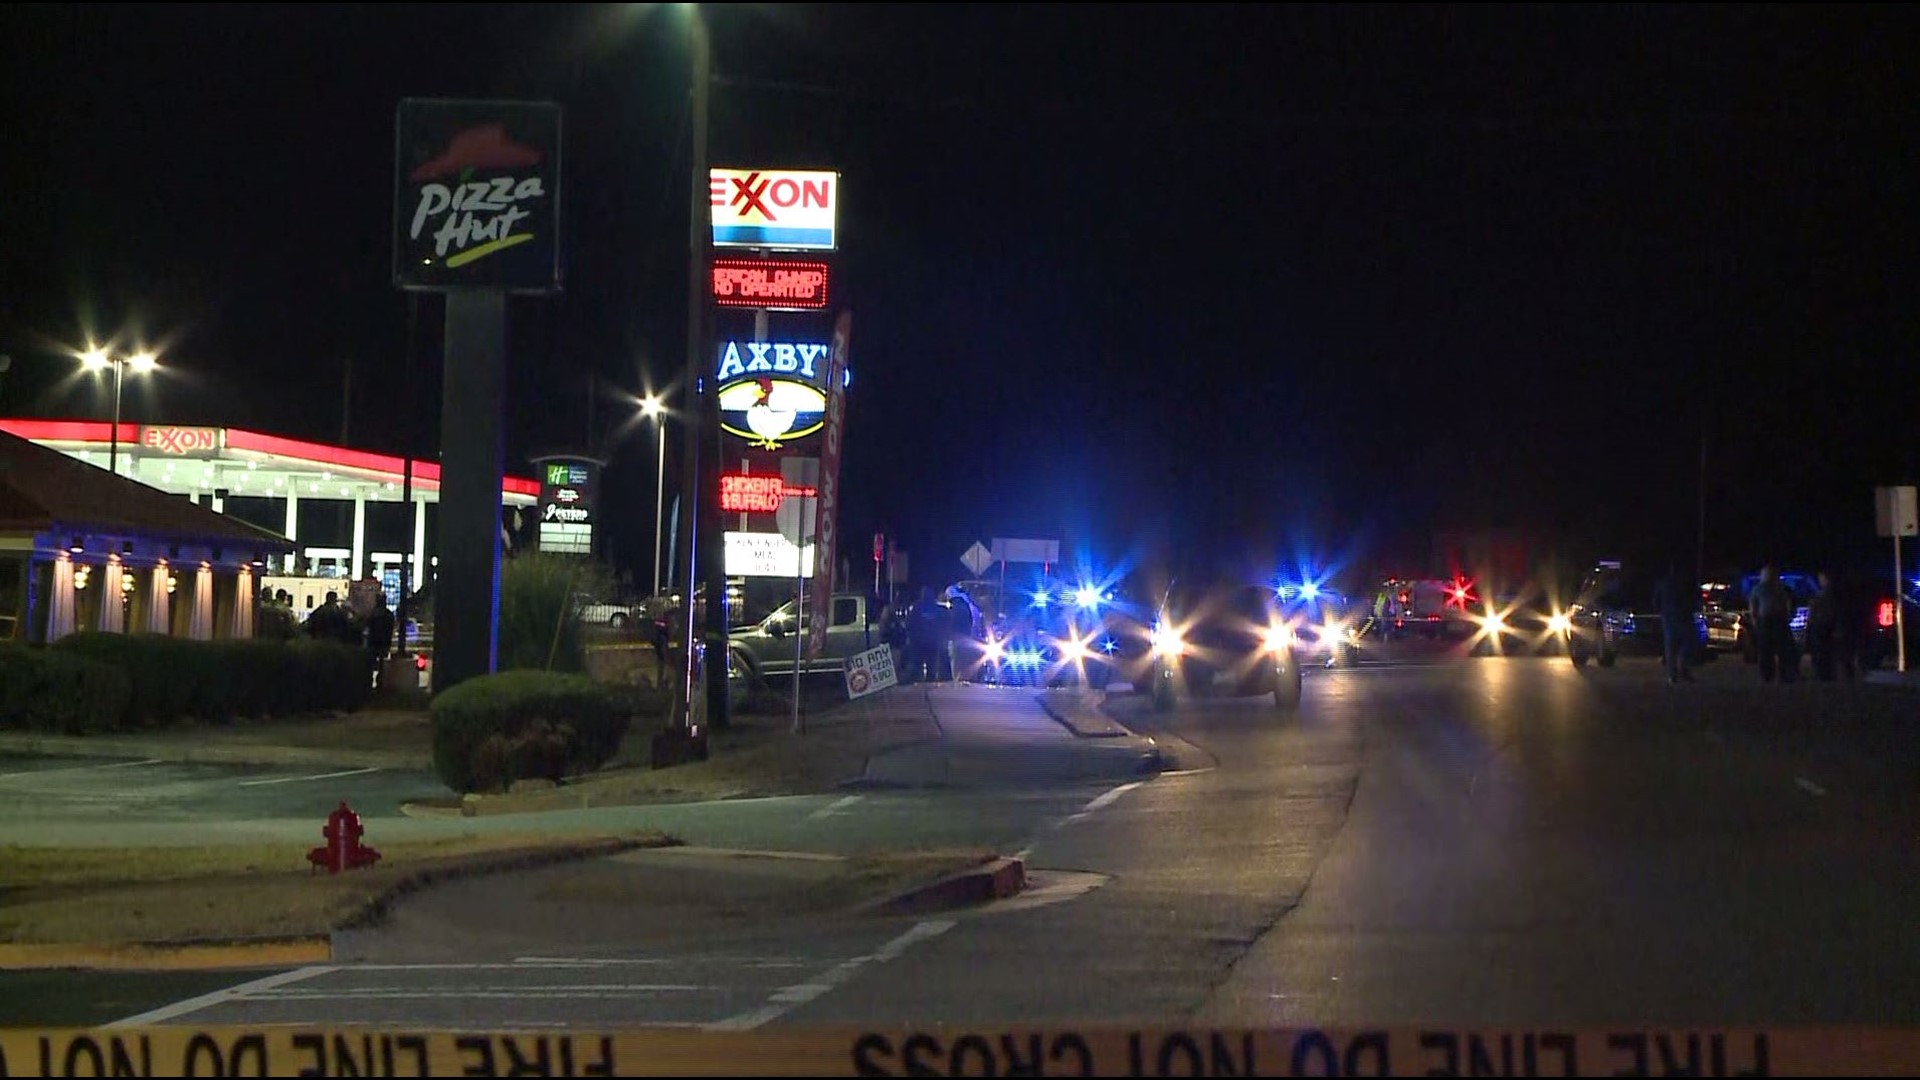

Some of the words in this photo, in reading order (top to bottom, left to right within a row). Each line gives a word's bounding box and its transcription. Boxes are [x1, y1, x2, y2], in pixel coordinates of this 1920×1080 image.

[410, 177, 545, 240] Pizza
[710, 172, 828, 221] EXXON
[434, 205, 530, 257] Hut
[714, 268, 767, 284] ERICAN
[774, 270, 823, 286] OWNED
[714, 280, 734, 295] ND
[740, 282, 815, 298] OPERATED
[717, 341, 849, 386] AXBY'
[144, 428, 212, 453] EXXON
[722, 476, 768, 494] CHICKEN
[867, 647, 889, 664] ANY
[39, 1035, 151, 1078] NOT
[184, 1034, 268, 1078] DO
[293, 1034, 429, 1078] LINE
[455, 1034, 614, 1078] FIRE
[851, 1031, 1093, 1078] CROSS
[1291, 1029, 1390, 1078] DO
[1420, 1032, 1577, 1078] LINE
[1608, 1033, 1770, 1078] FIRE
